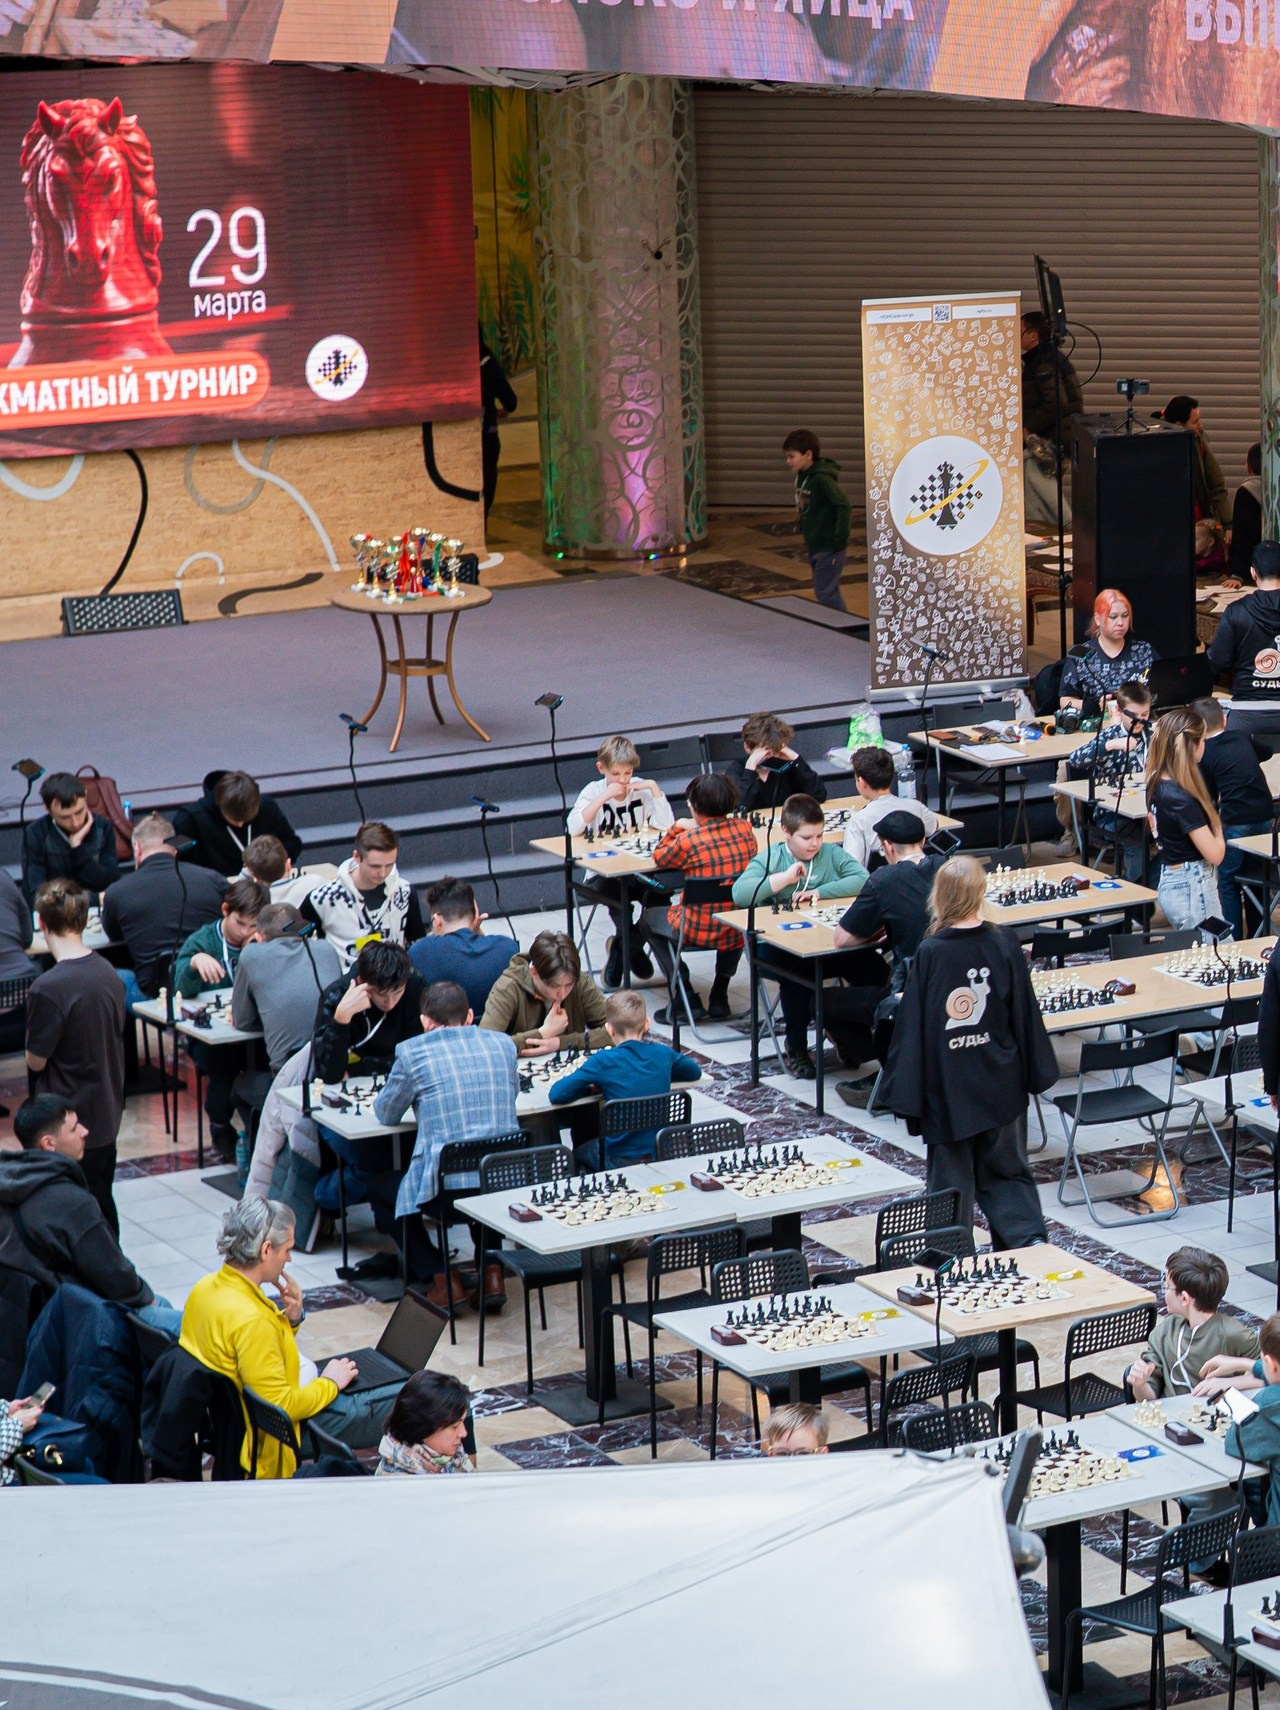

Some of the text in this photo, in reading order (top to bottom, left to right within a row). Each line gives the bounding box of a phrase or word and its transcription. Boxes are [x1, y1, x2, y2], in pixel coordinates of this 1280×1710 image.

[186, 206, 267, 288] 29
[194, 290, 267, 320] марта
[145, 364, 257, 401] ТУРНИР
